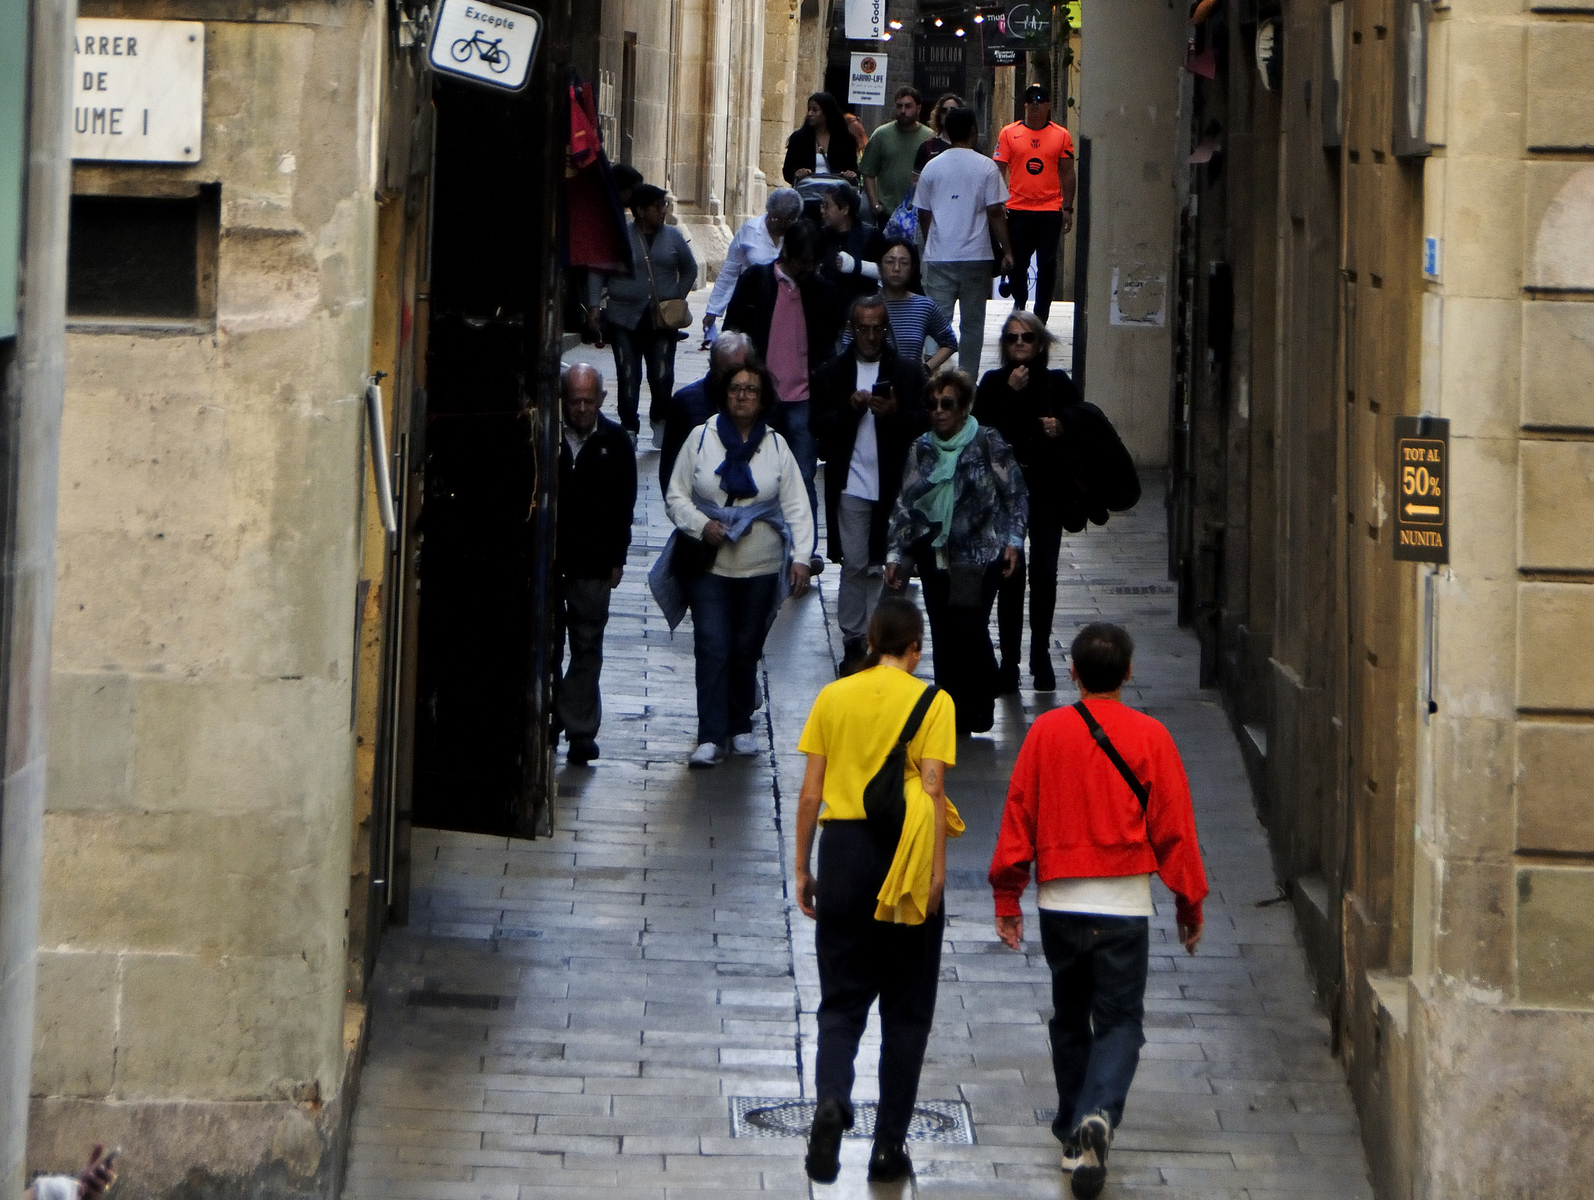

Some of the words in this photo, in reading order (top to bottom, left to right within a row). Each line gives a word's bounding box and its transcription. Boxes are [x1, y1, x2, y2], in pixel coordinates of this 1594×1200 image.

[465, 6, 515, 30] Excepte
[871, 27, 879, 38] Le
[83, 71, 108, 91] DE
[75, 107, 123, 135] UME
[143, 108, 148, 135] I
[1402, 466, 1441, 497] 50%
[1400, 529, 1443, 547] NUNITA
